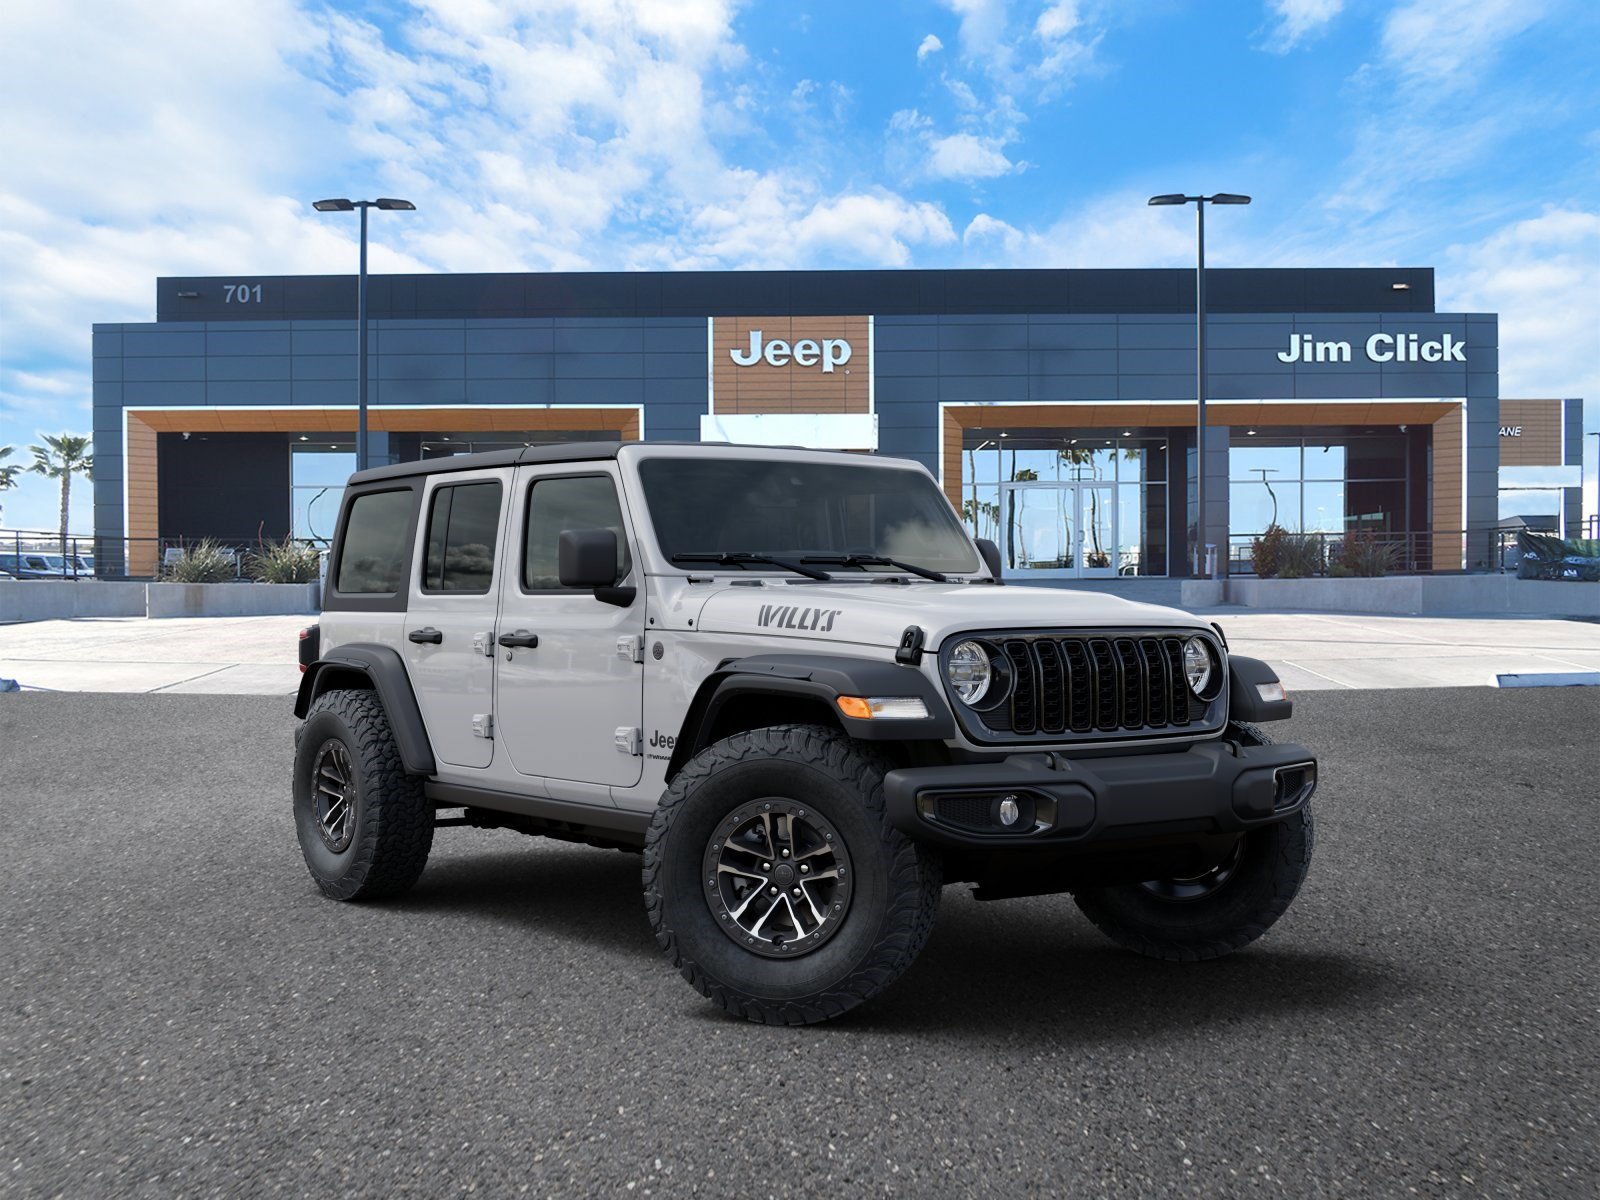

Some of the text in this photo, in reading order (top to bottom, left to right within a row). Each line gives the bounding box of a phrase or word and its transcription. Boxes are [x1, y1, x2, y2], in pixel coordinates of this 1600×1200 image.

[223, 284, 261, 303] 701
[729, 330, 852, 373] Jeep
[1277, 333, 1467, 362] Jim Click
[758, 605, 842, 632] WILLYS
